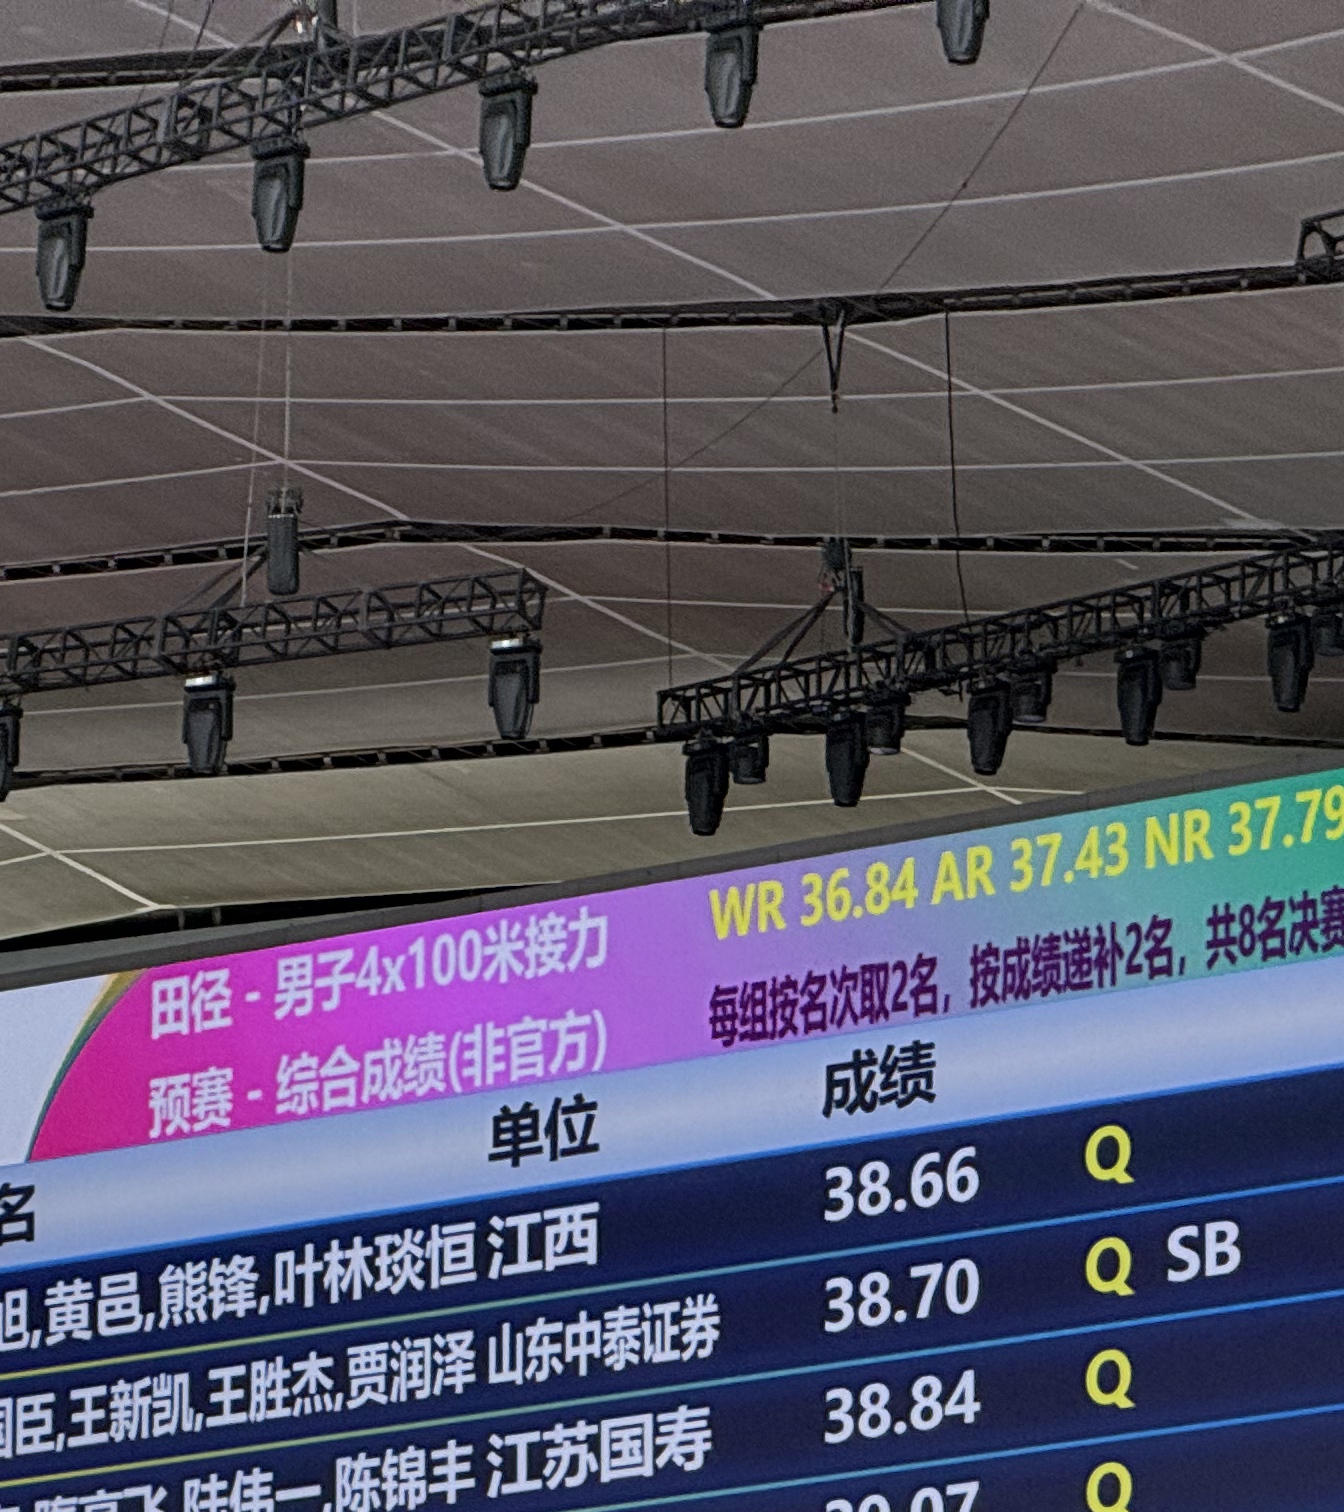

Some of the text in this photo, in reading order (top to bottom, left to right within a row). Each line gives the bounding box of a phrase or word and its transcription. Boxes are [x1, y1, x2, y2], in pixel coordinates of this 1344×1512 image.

[709, 879, 784, 939] WR
[802, 856, 918, 927] 36.84
[932, 845, 993, 906] AR
[1011, 822, 1128, 891] 37.43
[1145, 810, 1213, 869] NR
[151, 968, 232, 1040] 田径
[275, 906, 608, 1020] 男子4x100米接力
[148, 1066, 234, 1139] 预赛
[488, 1093, 600, 1167] 单位
[822, 1040, 936, 1118] 成绩
[488, 1203, 598, 1279] 江西
[825, 1147, 978, 1221] 38.66
[1086, 1126, 1132, 1183] Q
[489, 1294, 719, 1384] 山东中泰证券
[825, 1259, 979, 1331] 38.70
[1087, 1238, 1133, 1295] Q
[1168, 1221, 1243, 1281] SB
[487, 1406, 711, 1497] 江苏国寿
[825, 1370, 980, 1443] 38.84
[1087, 1350, 1133, 1408] Q
